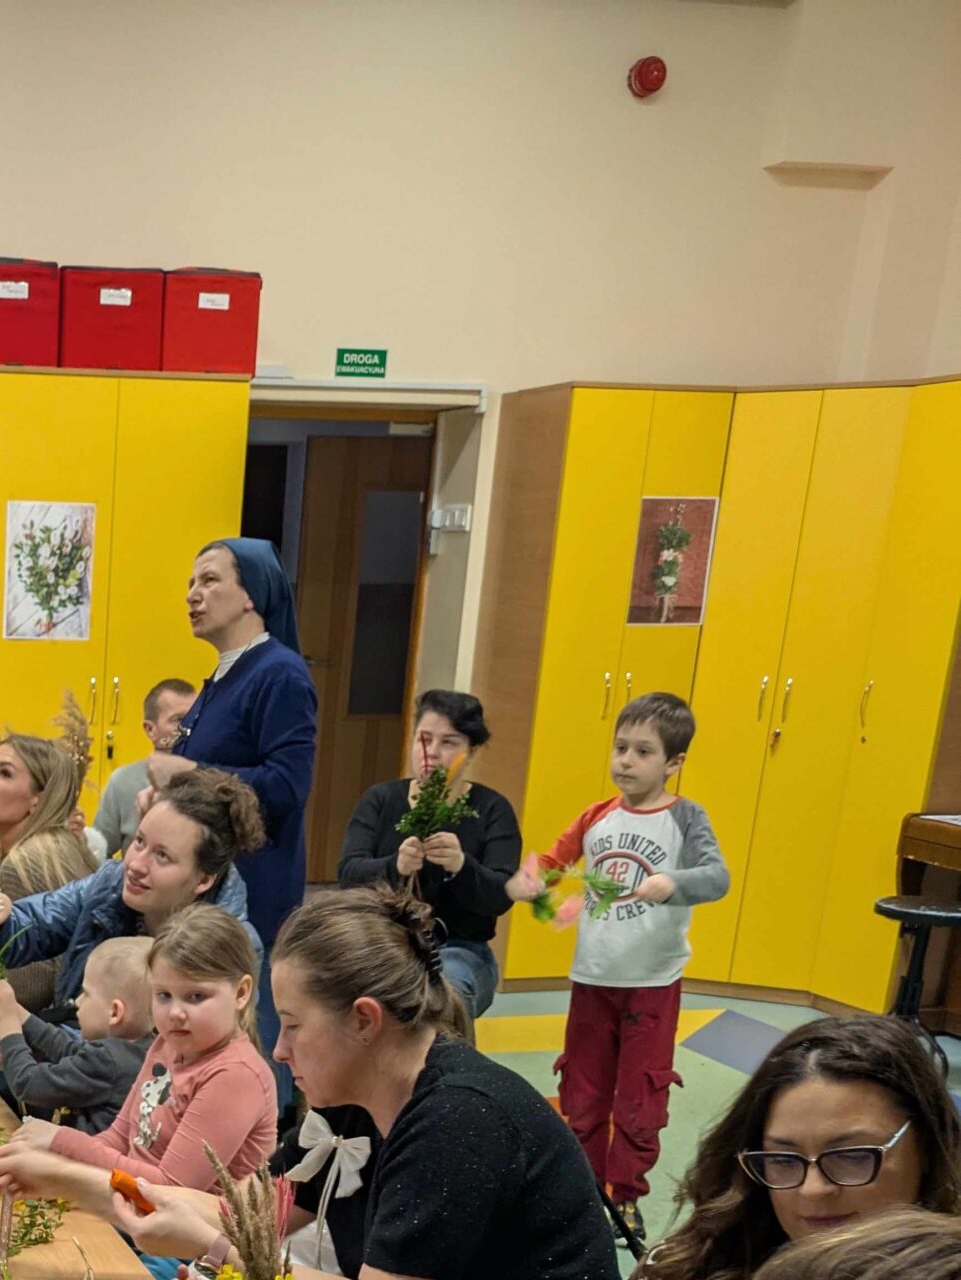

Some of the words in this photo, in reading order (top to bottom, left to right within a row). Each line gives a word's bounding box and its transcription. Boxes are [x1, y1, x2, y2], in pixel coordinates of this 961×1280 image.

[343, 353, 380, 365] DROGA
[617, 832, 668, 866] UNITED
[606, 861, 629, 883] 42
[615, 898, 654, 921] CRE
